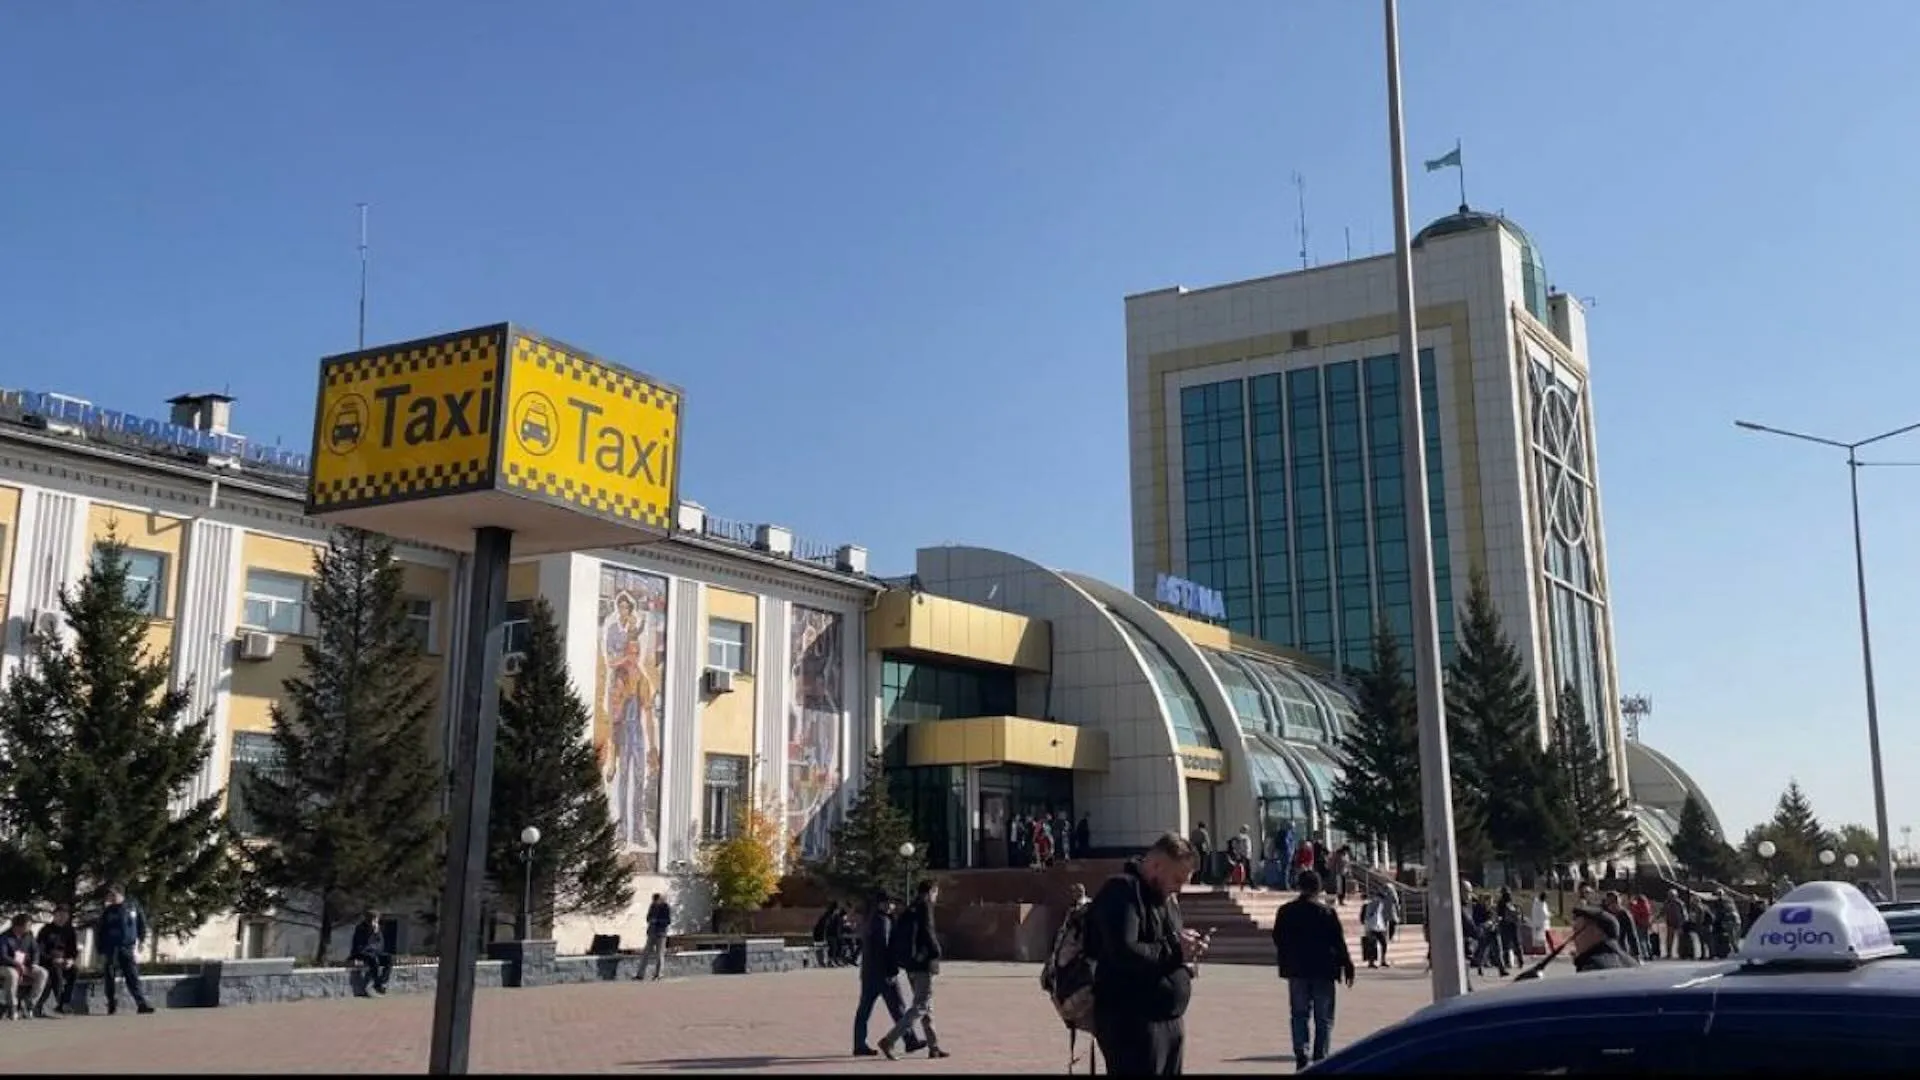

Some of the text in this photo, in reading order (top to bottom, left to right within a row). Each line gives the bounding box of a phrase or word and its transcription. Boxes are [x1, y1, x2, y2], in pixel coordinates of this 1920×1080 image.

[375, 371, 492, 448] Taxi
[567, 397, 671, 488] Taxi
[1760, 928, 1834, 951] region
